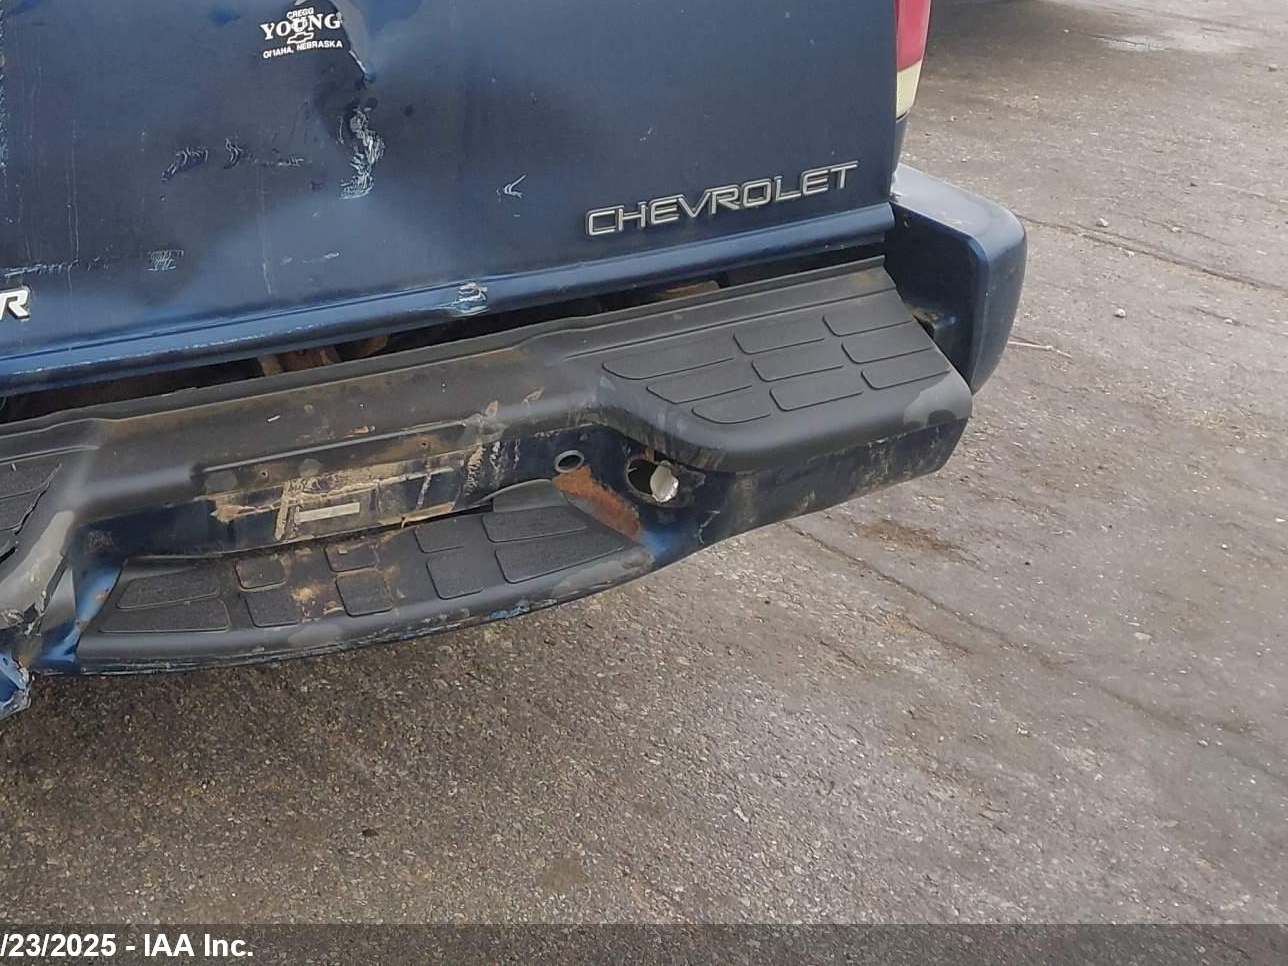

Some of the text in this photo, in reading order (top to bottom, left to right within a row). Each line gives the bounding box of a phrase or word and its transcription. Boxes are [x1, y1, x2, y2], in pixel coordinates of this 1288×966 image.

[260, 13, 342, 40] YOUNG
[297, 40, 343, 51] NEBRASKA
[586, 160, 859, 236] CHEVROLET
